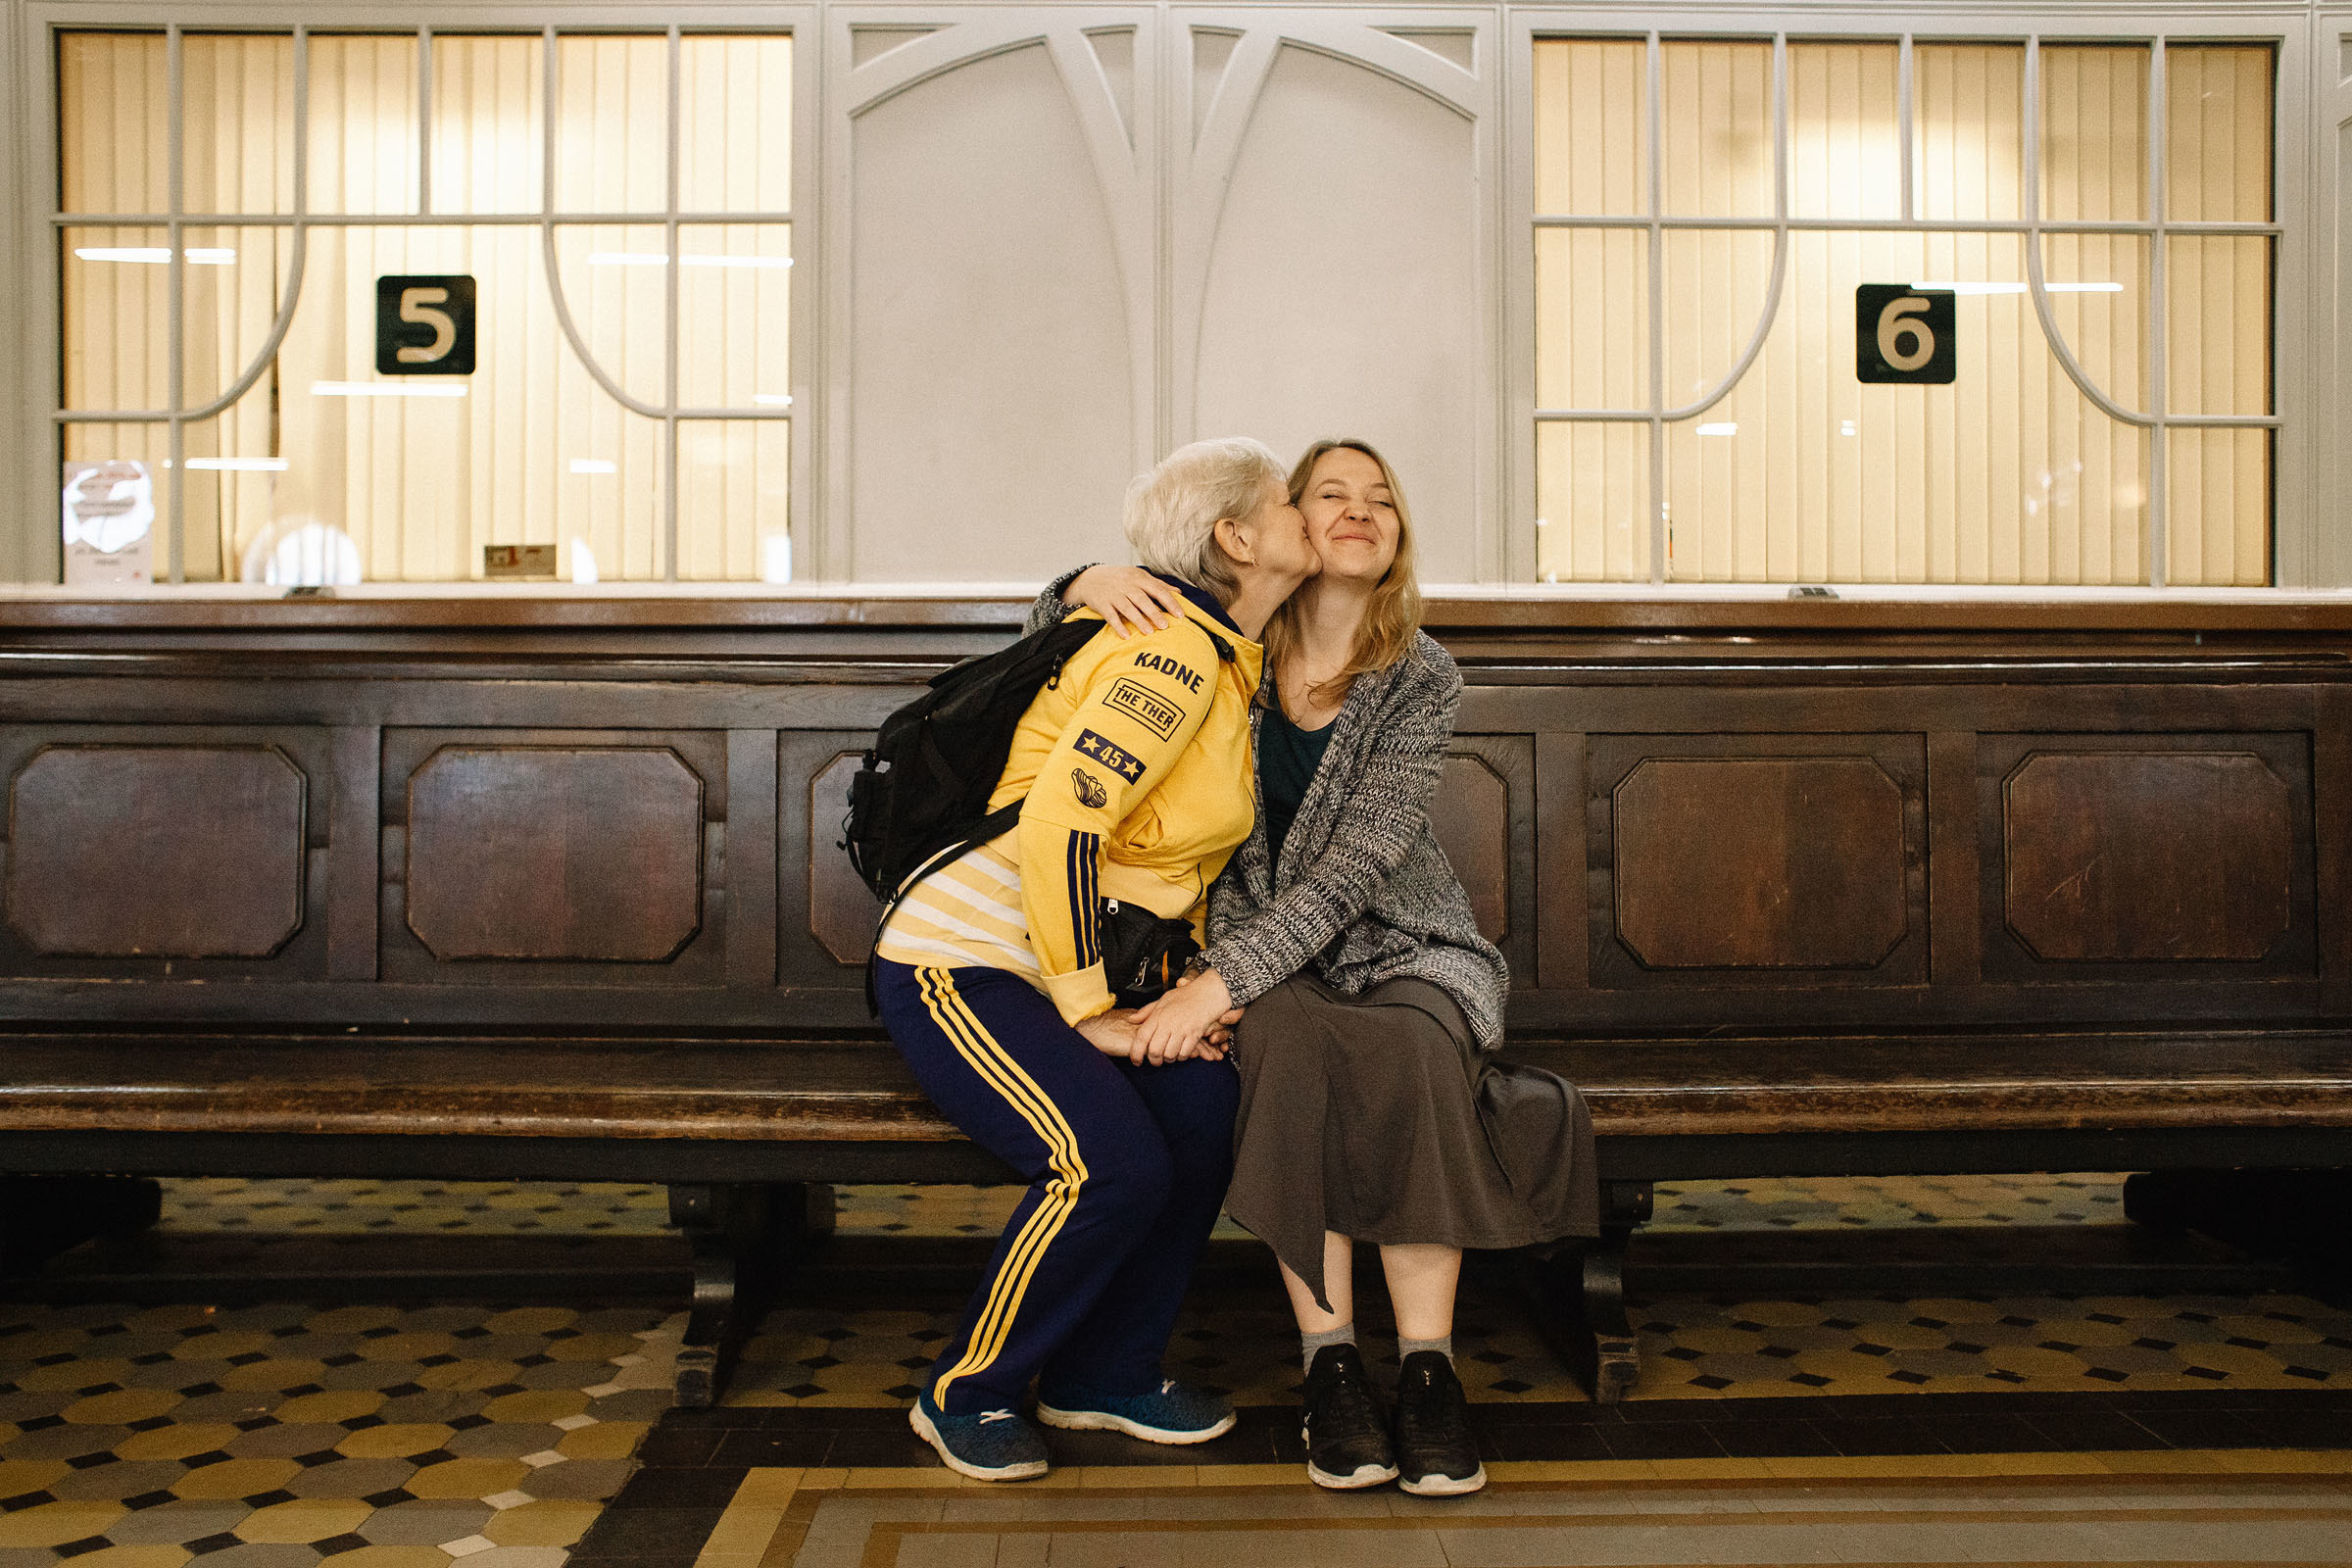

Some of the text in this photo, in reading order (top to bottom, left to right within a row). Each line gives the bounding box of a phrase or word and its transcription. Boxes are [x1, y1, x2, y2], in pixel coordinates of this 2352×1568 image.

[396, 287, 456, 364] 5
[1876, 296, 1936, 371] 6
[1134, 652, 1204, 695] KADNE
[1115, 687, 1175, 728] THE THER
[1099, 745, 1125, 768] 45
